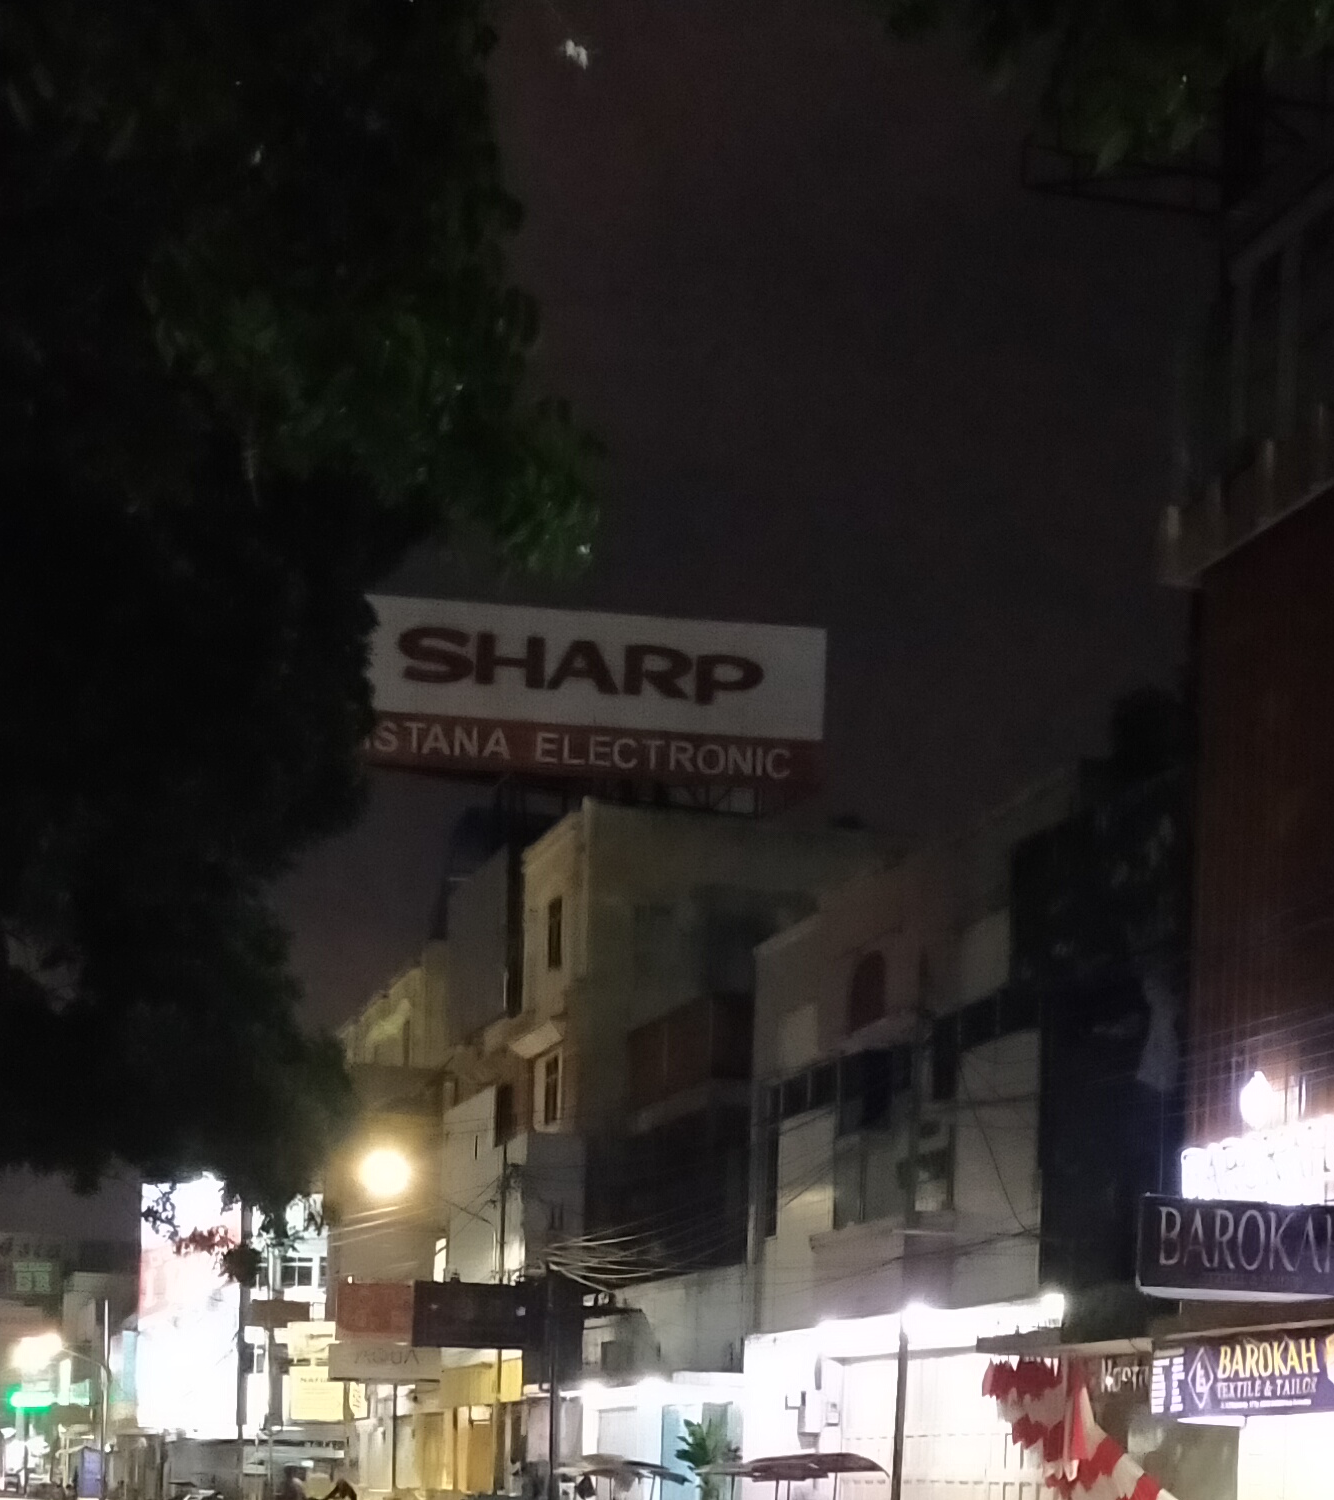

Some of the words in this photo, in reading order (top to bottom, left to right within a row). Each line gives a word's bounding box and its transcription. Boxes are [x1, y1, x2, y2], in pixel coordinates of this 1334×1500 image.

[398, 626, 764, 706] SHARP
[534, 732, 792, 779] ELECTRONIC
[1216, 1339, 1320, 1380] BAROKAH
[1217, 1380, 1261, 1399] TEXTILE
[1263, 1380, 1273, 1397] &
[1275, 1377, 1318, 1396] TAILOR
